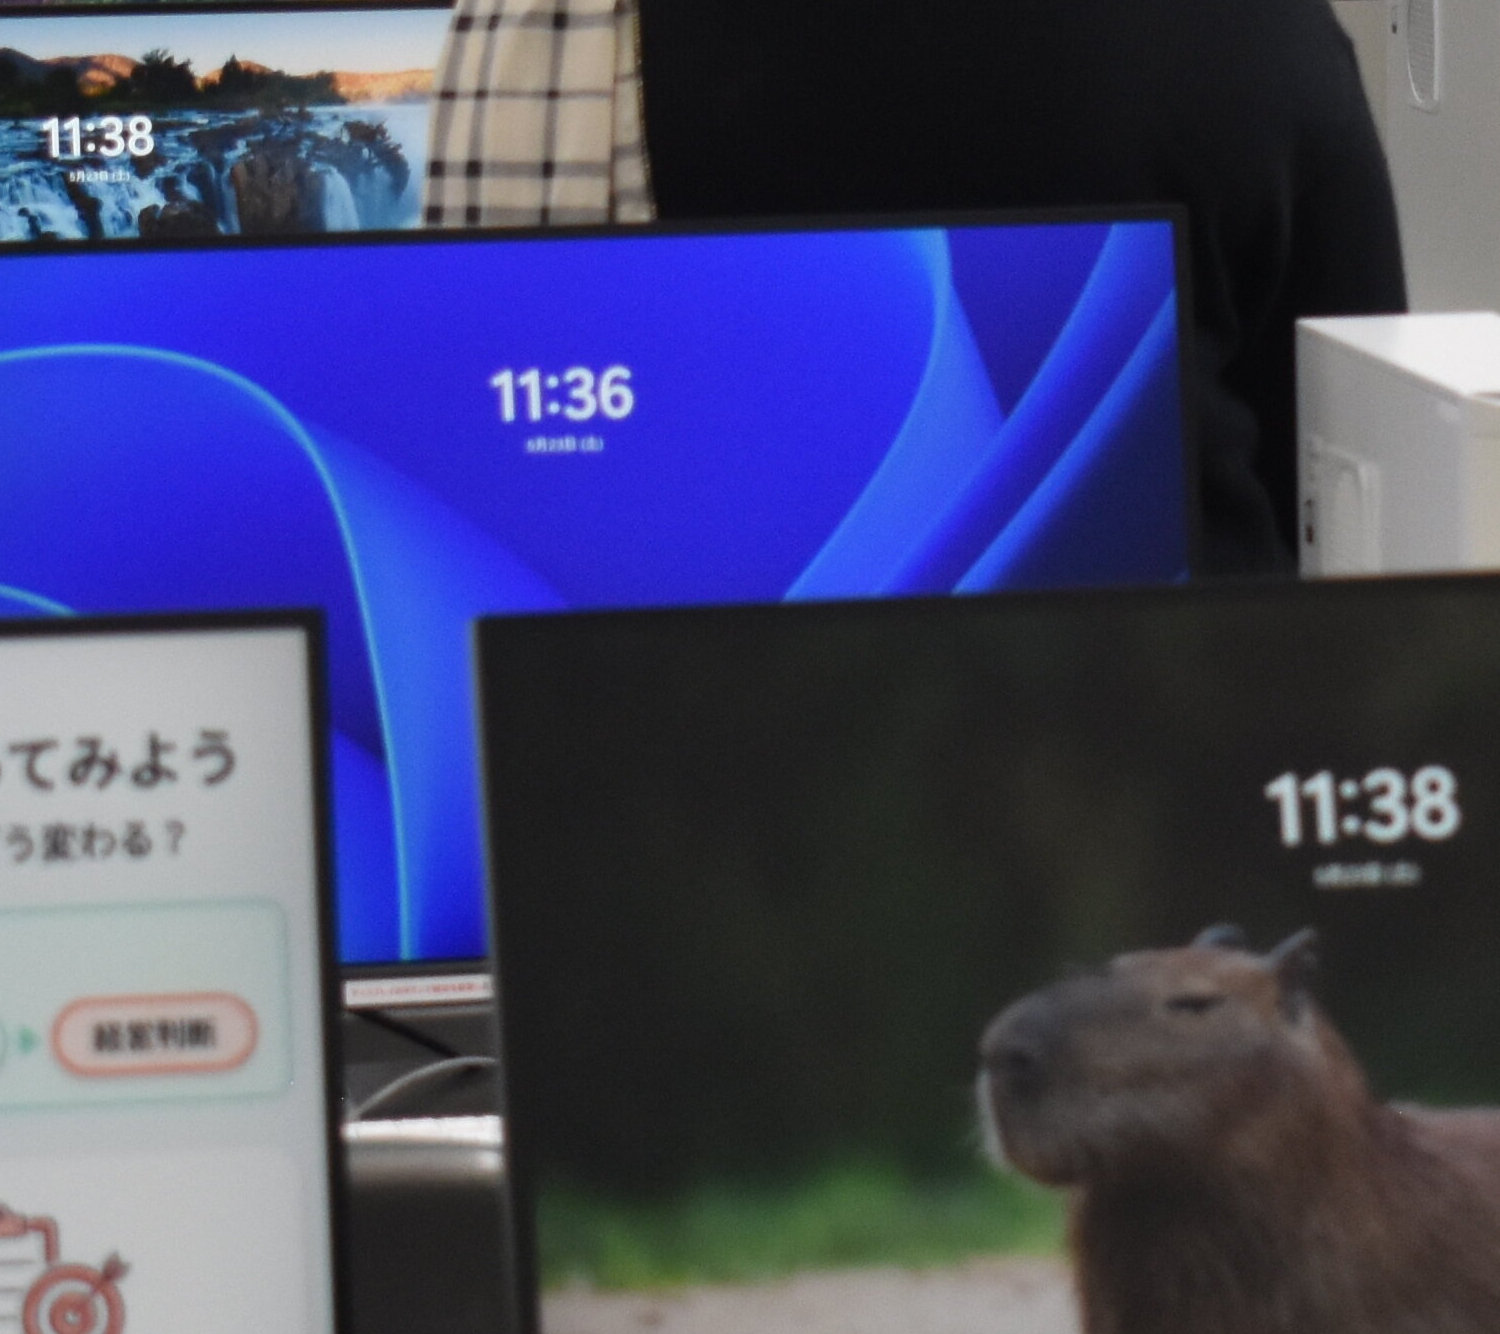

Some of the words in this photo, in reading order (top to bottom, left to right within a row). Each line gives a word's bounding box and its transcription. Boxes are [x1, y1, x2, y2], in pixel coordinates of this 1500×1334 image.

[42, 116, 155, 158] 11:38
[491, 365, 635, 423] 11:36
[1263, 764, 1462, 848] 11:38
